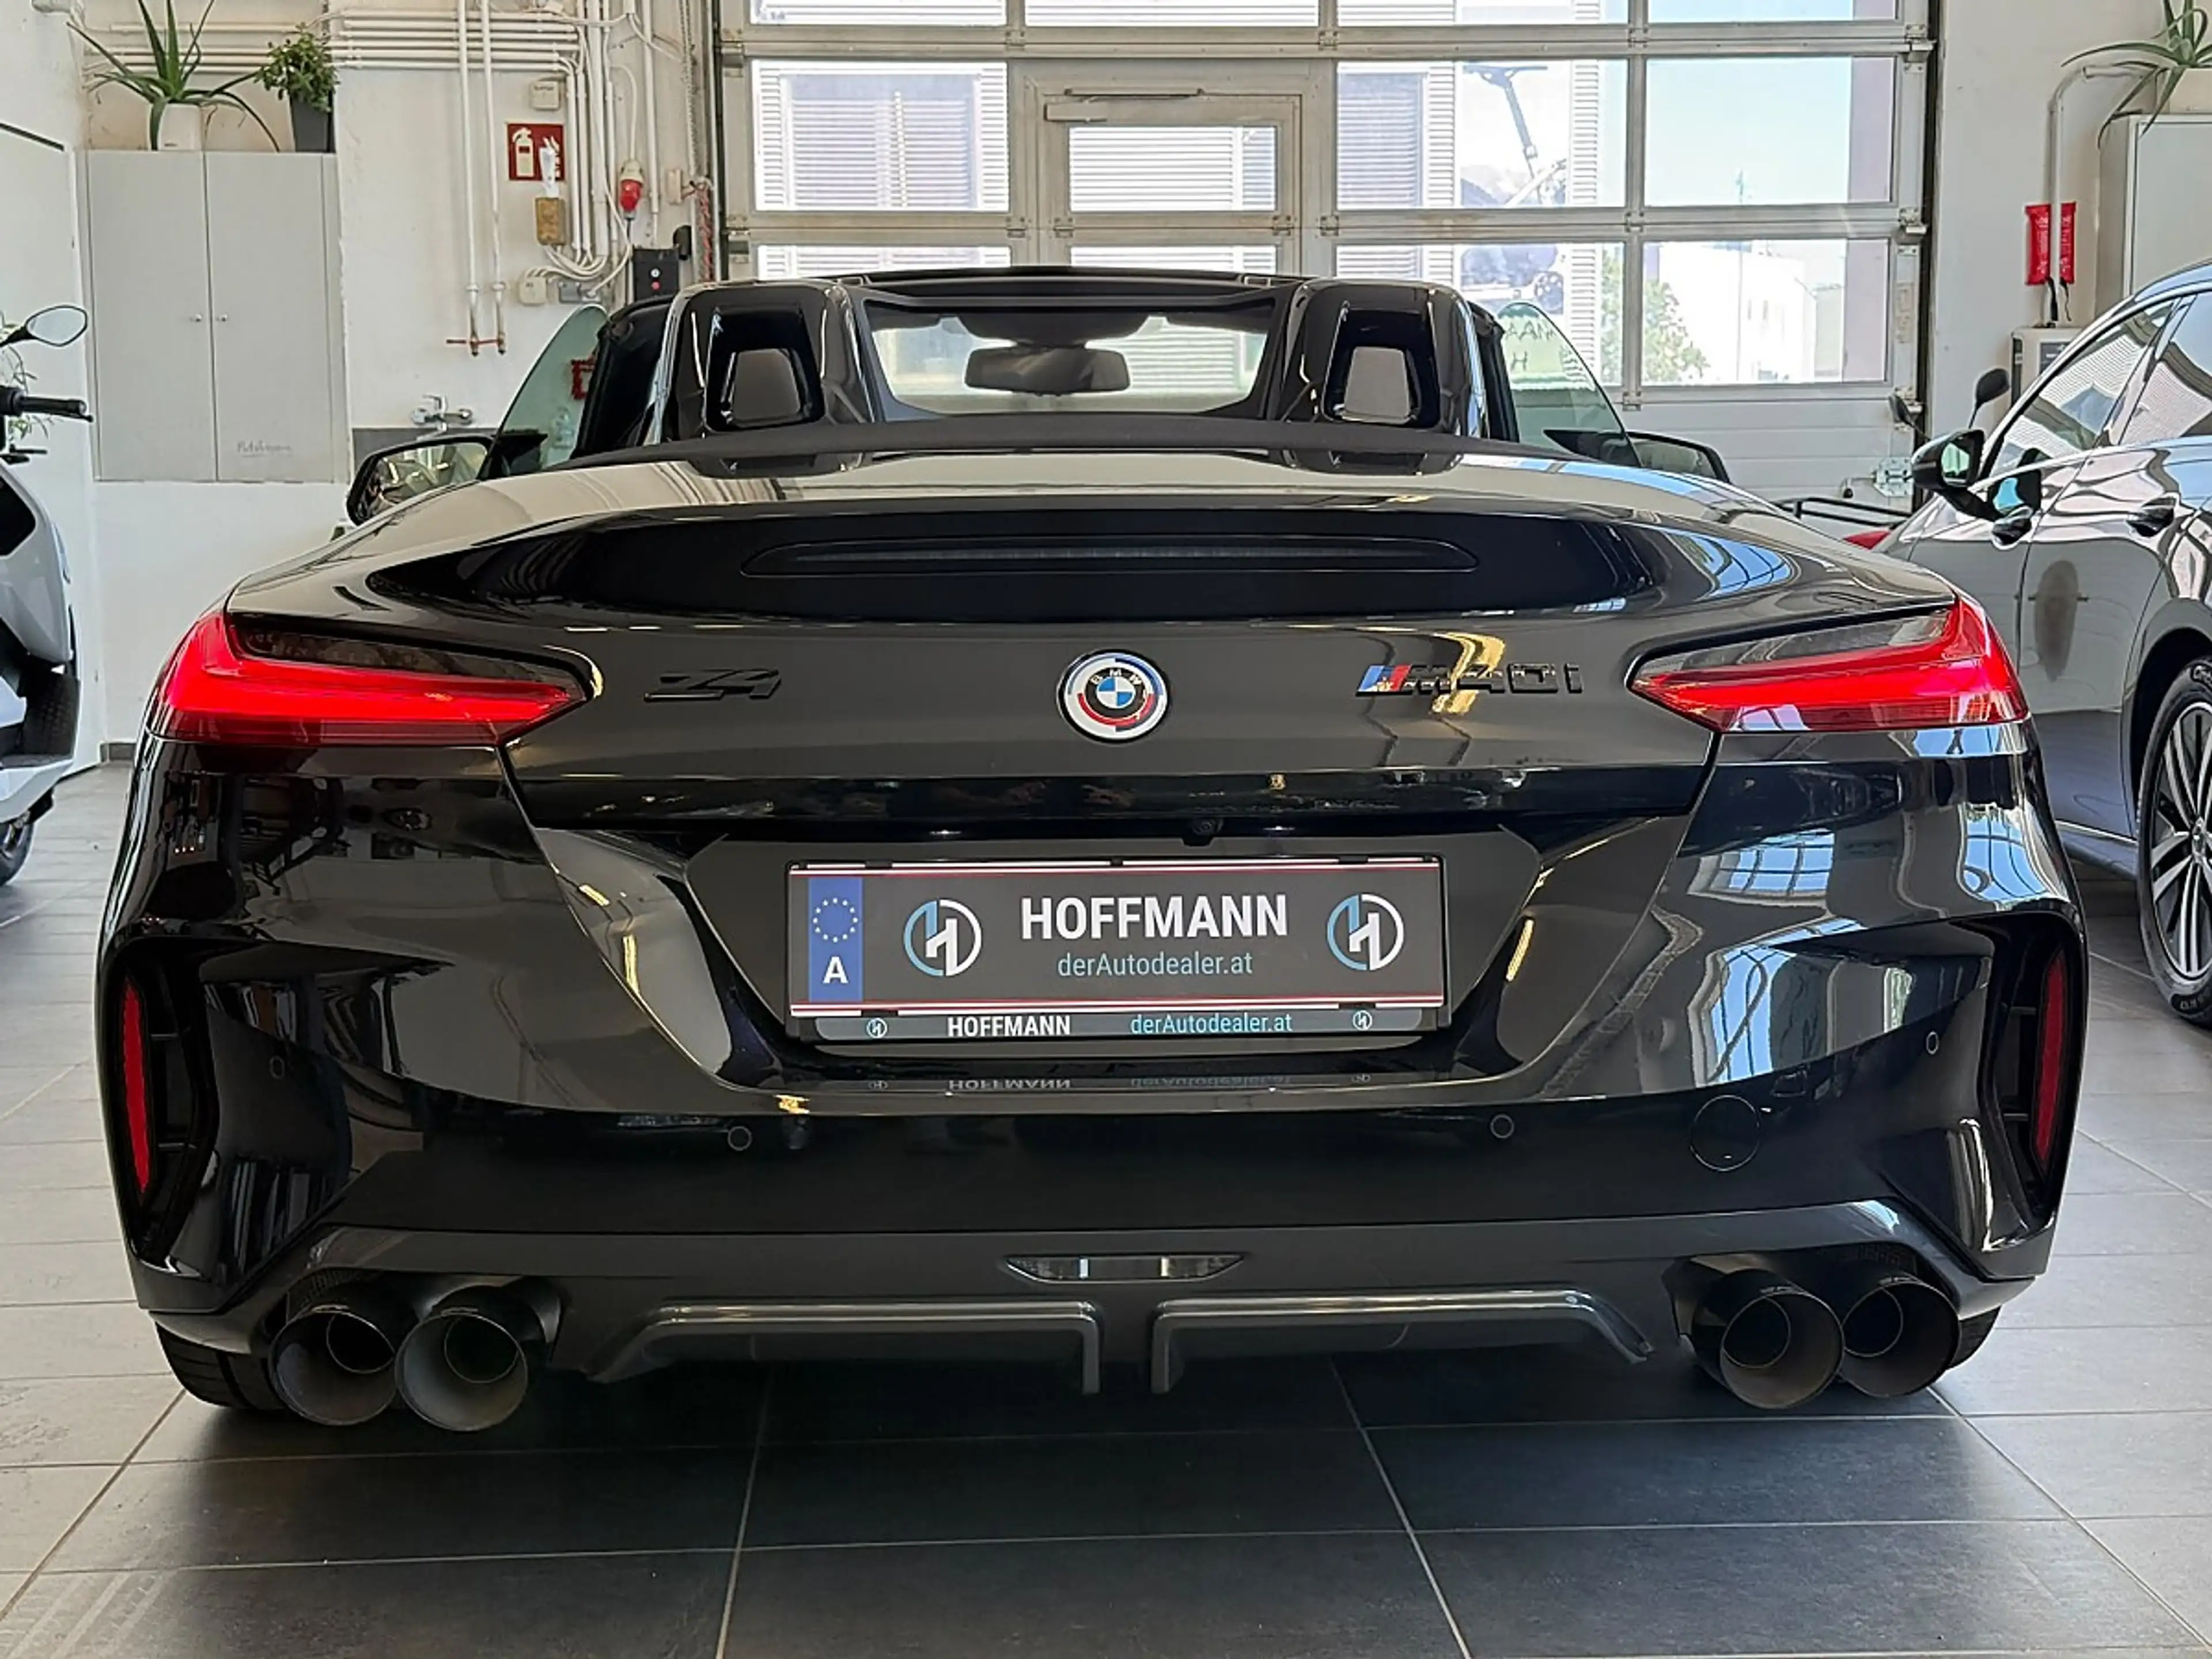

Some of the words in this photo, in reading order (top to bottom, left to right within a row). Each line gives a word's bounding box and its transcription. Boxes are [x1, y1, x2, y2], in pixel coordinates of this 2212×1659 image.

[643, 668, 781, 702] Z4
[1090, 668, 1143, 686] BMW
[1021, 895, 1288, 940] HOFFMANN
[823, 956, 849, 983] A
[1058, 953, 1253, 977] derAutodealer.at
[948, 1016, 1070, 1037] HOFFMANN
[1130, 1013, 1293, 1035] derAutodealer.at
